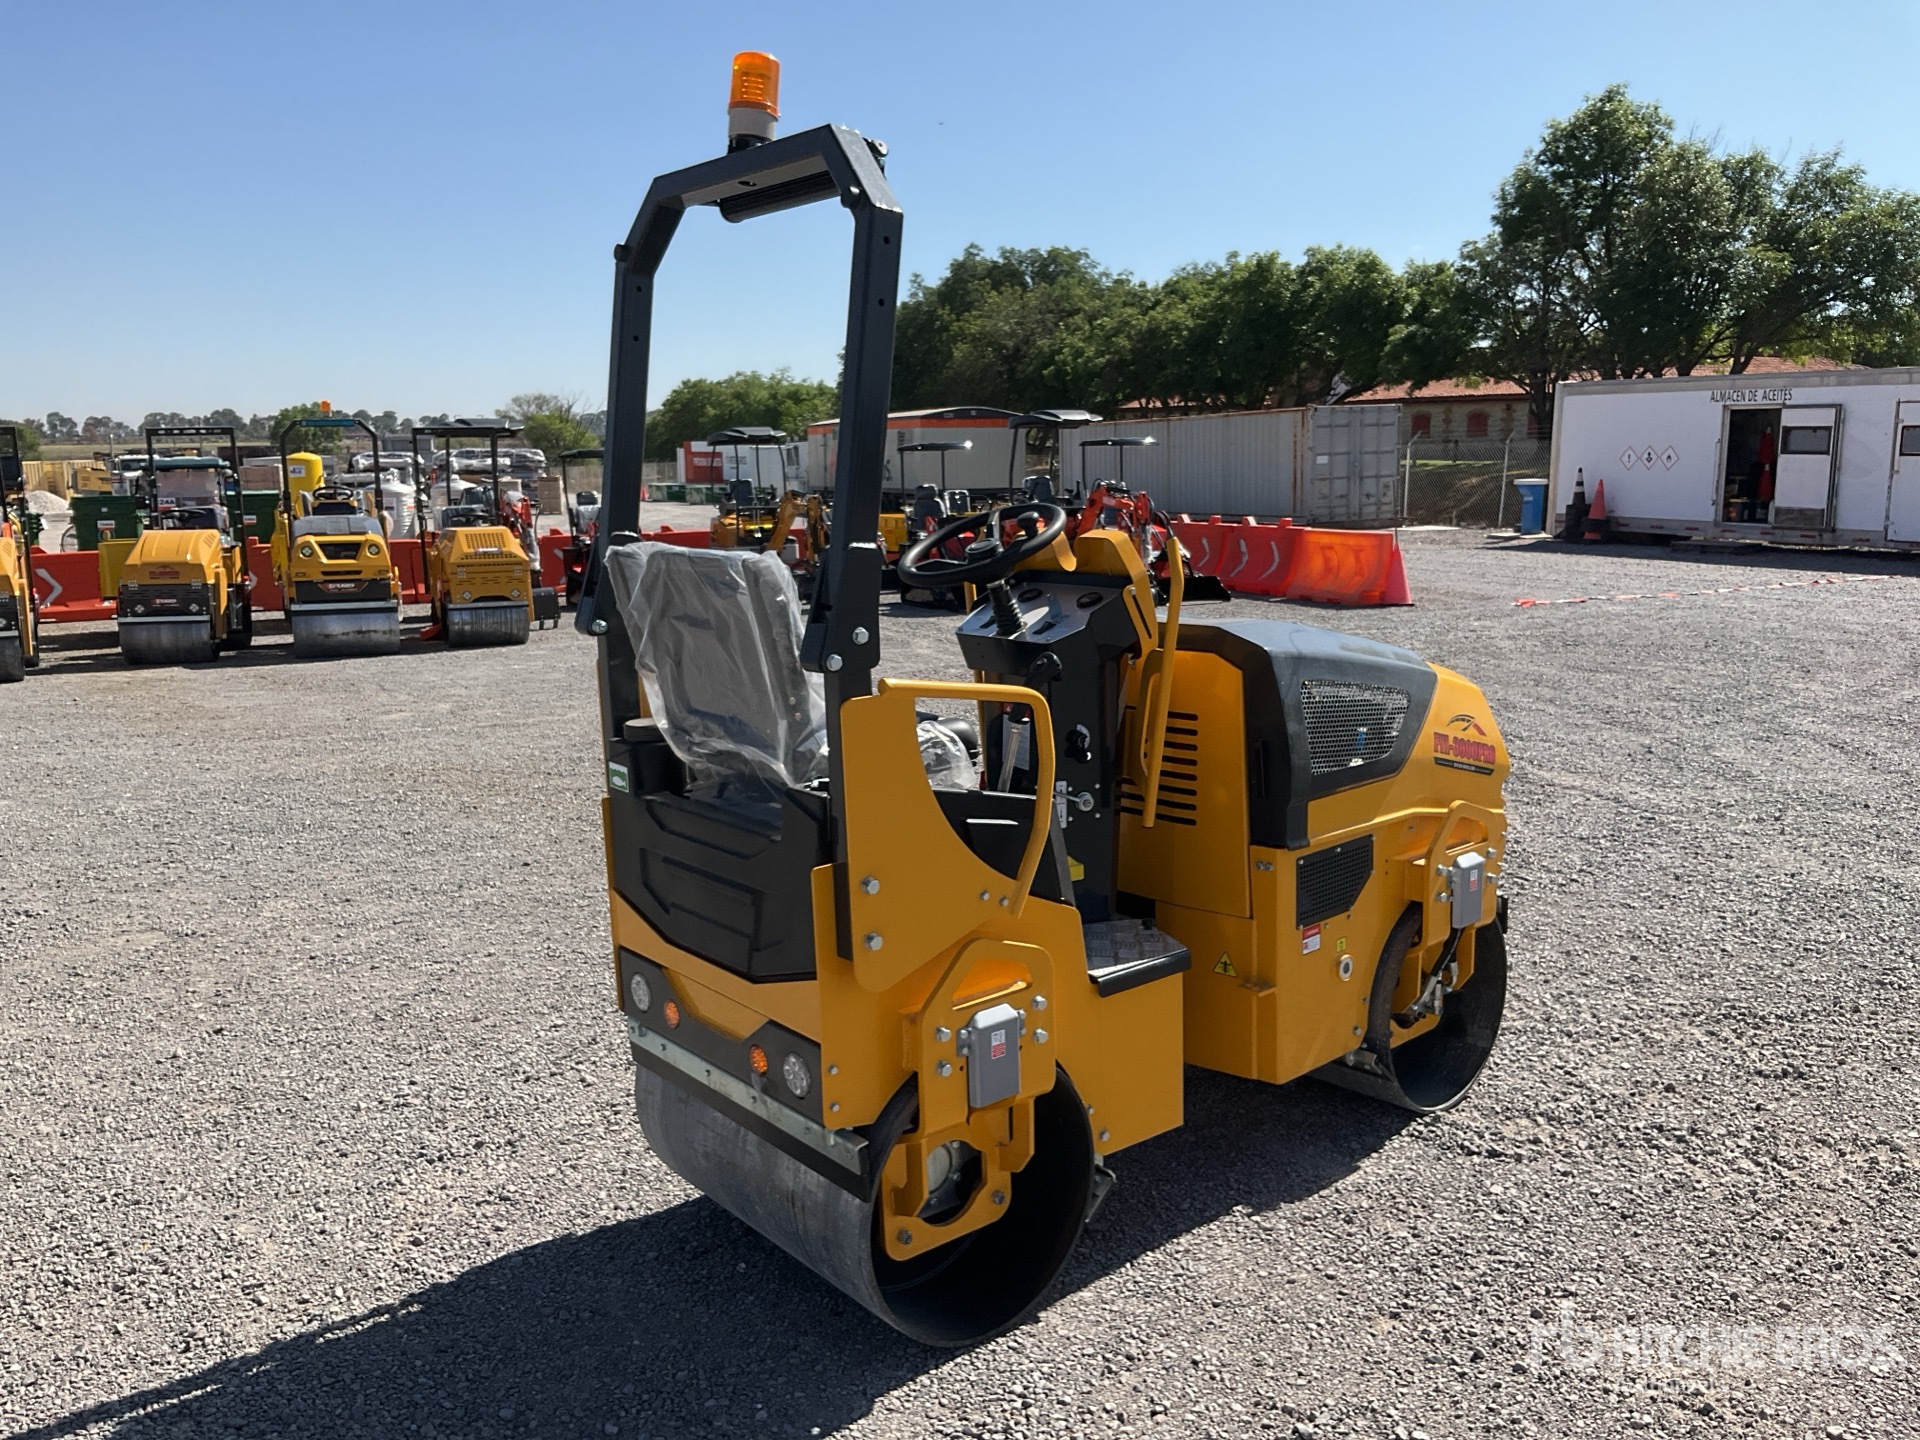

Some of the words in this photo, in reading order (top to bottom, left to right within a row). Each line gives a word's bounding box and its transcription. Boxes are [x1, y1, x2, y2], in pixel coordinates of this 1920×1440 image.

[1710, 390, 1746, 403] ALMACEN
[1748, 390, 1758, 402] DE
[1761, 388, 1793, 402] ACEITES
